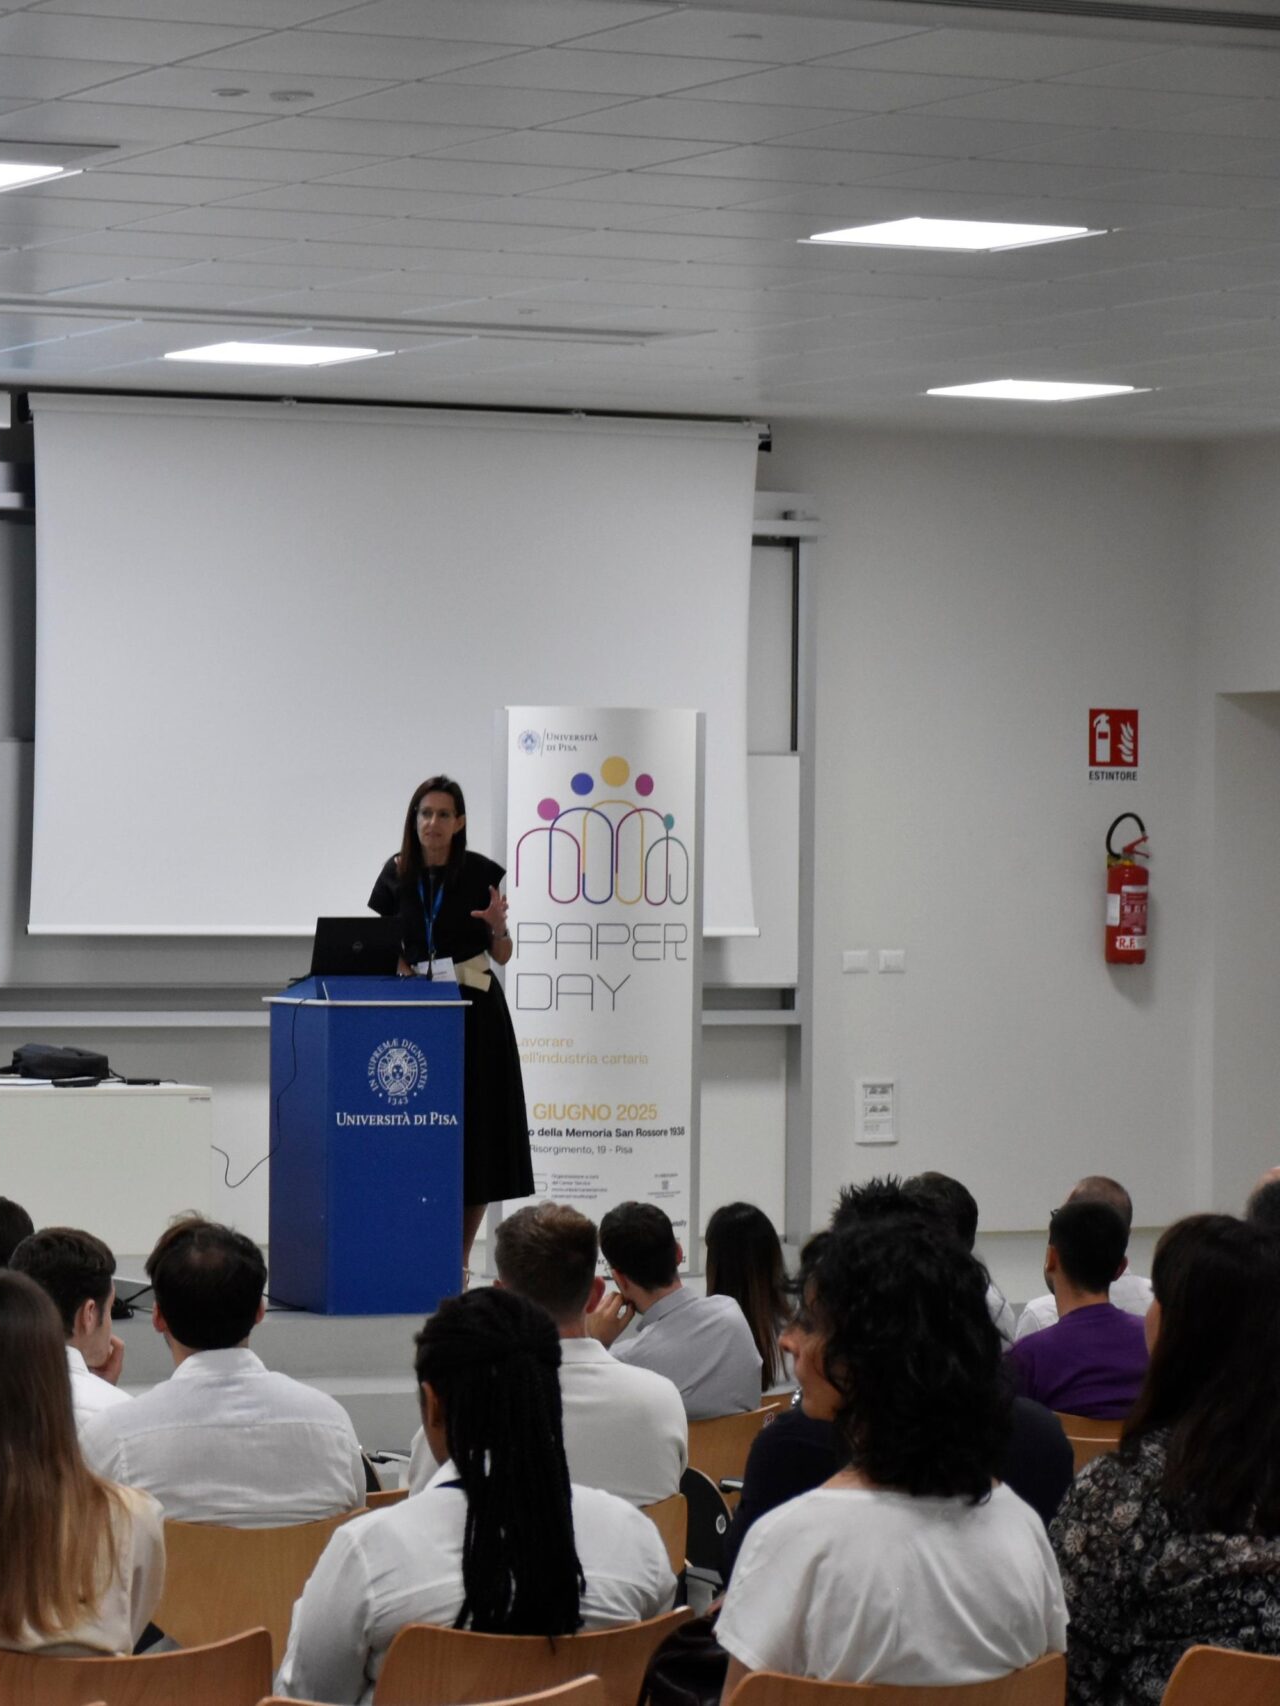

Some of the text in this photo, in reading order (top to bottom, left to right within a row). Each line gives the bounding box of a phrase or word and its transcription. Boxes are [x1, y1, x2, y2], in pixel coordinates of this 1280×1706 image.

[546, 731, 599, 742] UNIVERSITÀ
[558, 743, 578, 752] PISA
[1088, 771, 1138, 781] ESTINTORE
[516, 922, 688, 961] PAPER
[516, 973, 632, 1012] DAY
[519, 1037, 575, 1048] avorare
[401, 1039, 428, 1090] DIGNITATIS
[520, 1052, 649, 1065] ell'industria cartaria
[532, 1103, 658, 1121] GIUGNO 2025
[335, 1111, 458, 1126] UNIVERSITÀ DI PISA
[537, 1127, 563, 1137] della
[565, 1128, 613, 1138] Memoria
[615, 1128, 634, 1138] San
[636, 1128, 668, 1137] Rossore
[669, 1126, 686, 1136] 1938
[597, 1145, 607, 1154] 19
[615, 1145, 633, 1154] Pisa
